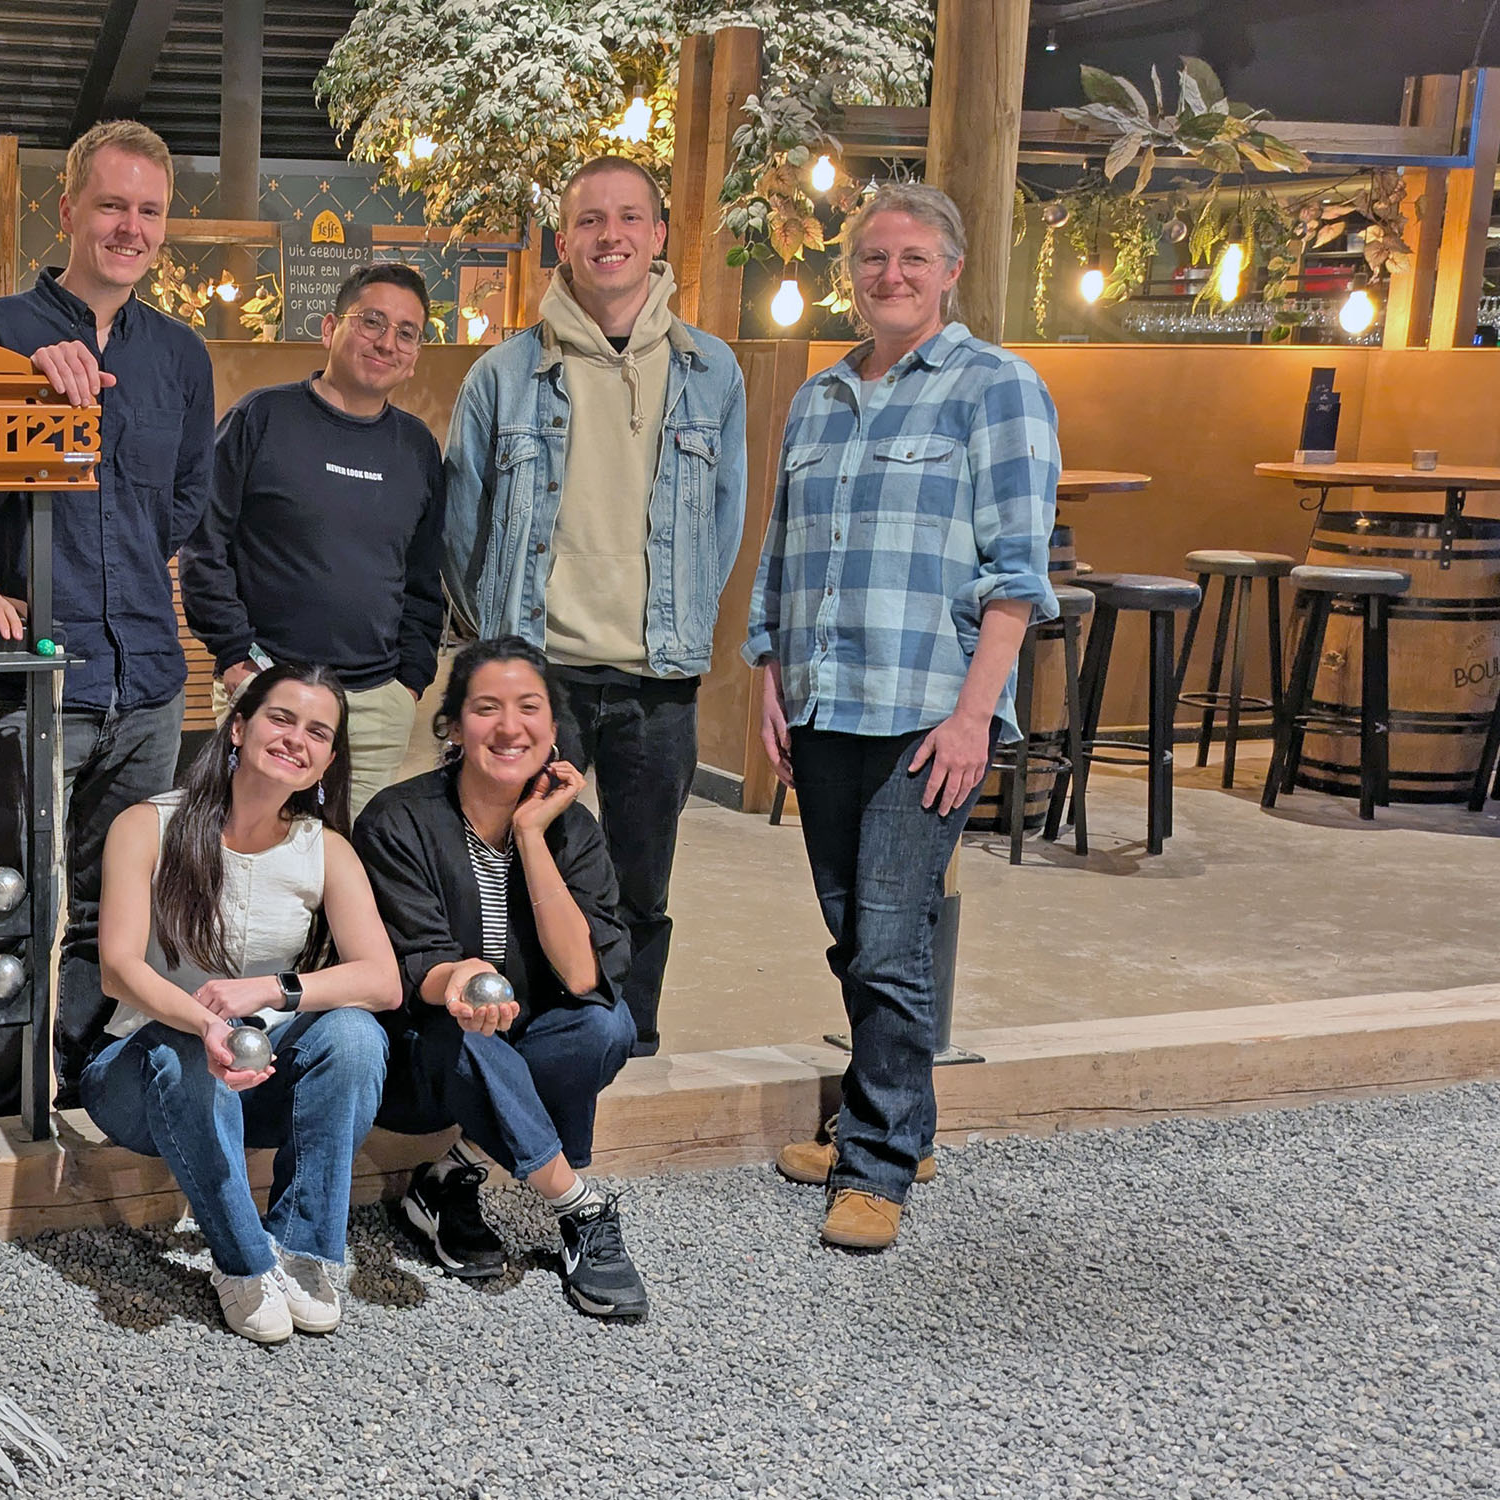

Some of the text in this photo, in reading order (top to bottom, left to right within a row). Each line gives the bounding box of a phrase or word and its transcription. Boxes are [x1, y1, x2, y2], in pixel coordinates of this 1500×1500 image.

[317, 221, 340, 238] Leffe
[290, 265, 316, 277] HUUR
[290, 299, 303, 310] OF
[326, 462, 383, 481] NEVER LOOK BACK
